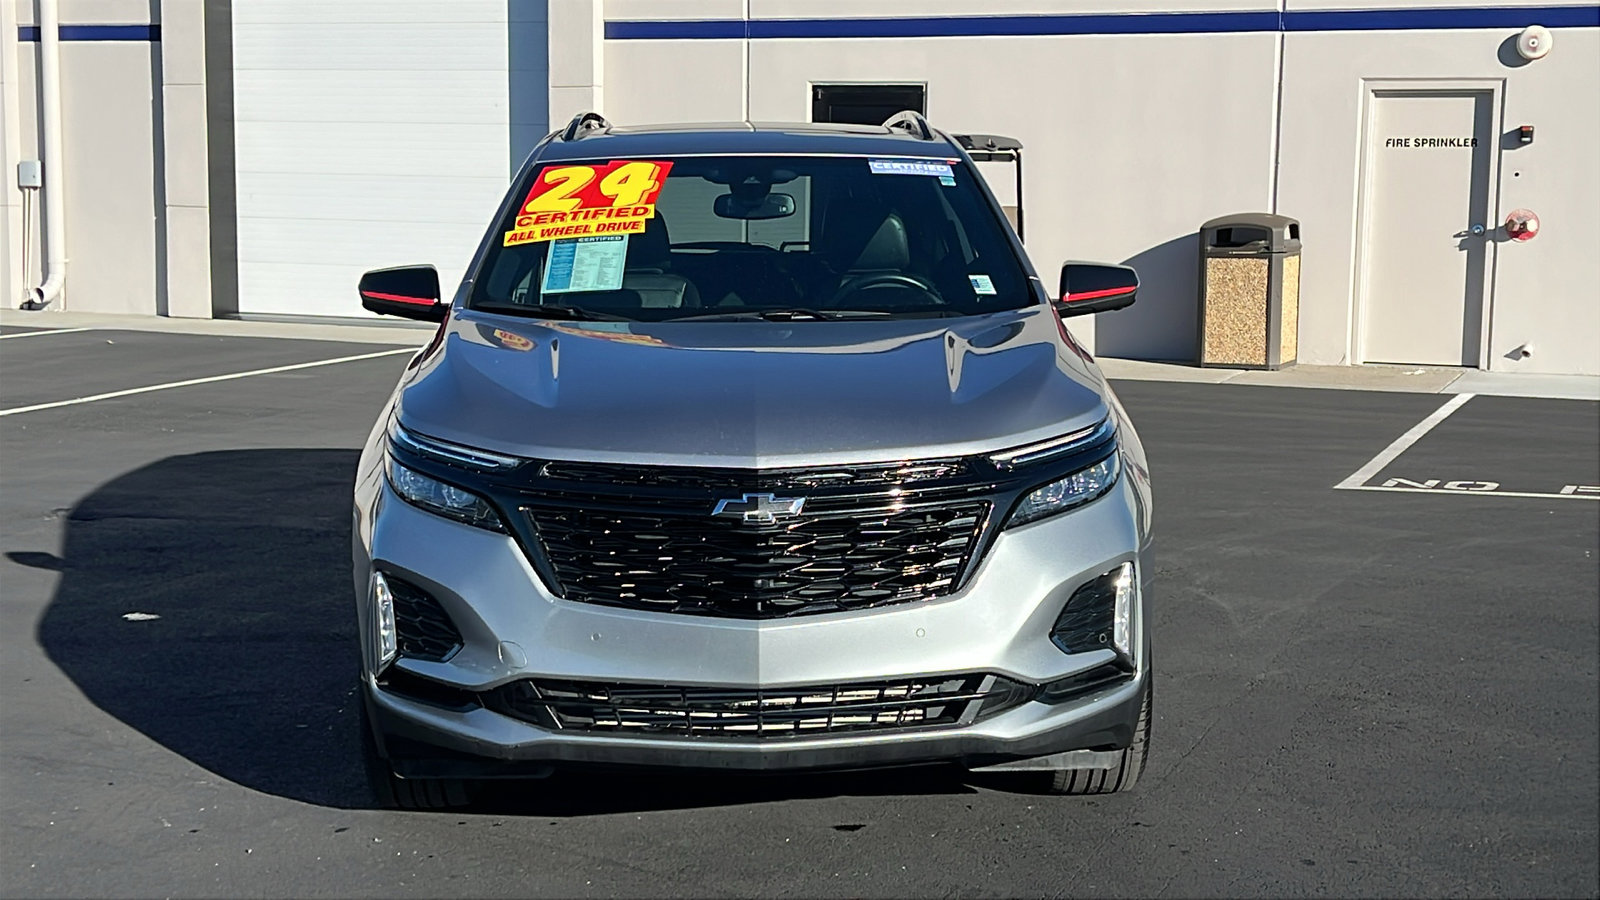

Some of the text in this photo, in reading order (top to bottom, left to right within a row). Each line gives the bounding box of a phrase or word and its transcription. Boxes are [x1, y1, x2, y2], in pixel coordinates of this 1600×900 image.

[1385, 137, 1479, 148] FIRE SPRINKLER
[873, 162, 948, 172] CERTIFIED
[525, 162, 660, 212] 24
[516, 206, 650, 228] CERTIFIED
[506, 221, 642, 243] ALL WHEEL DRIVE
[1381, 477, 1500, 491] NO
